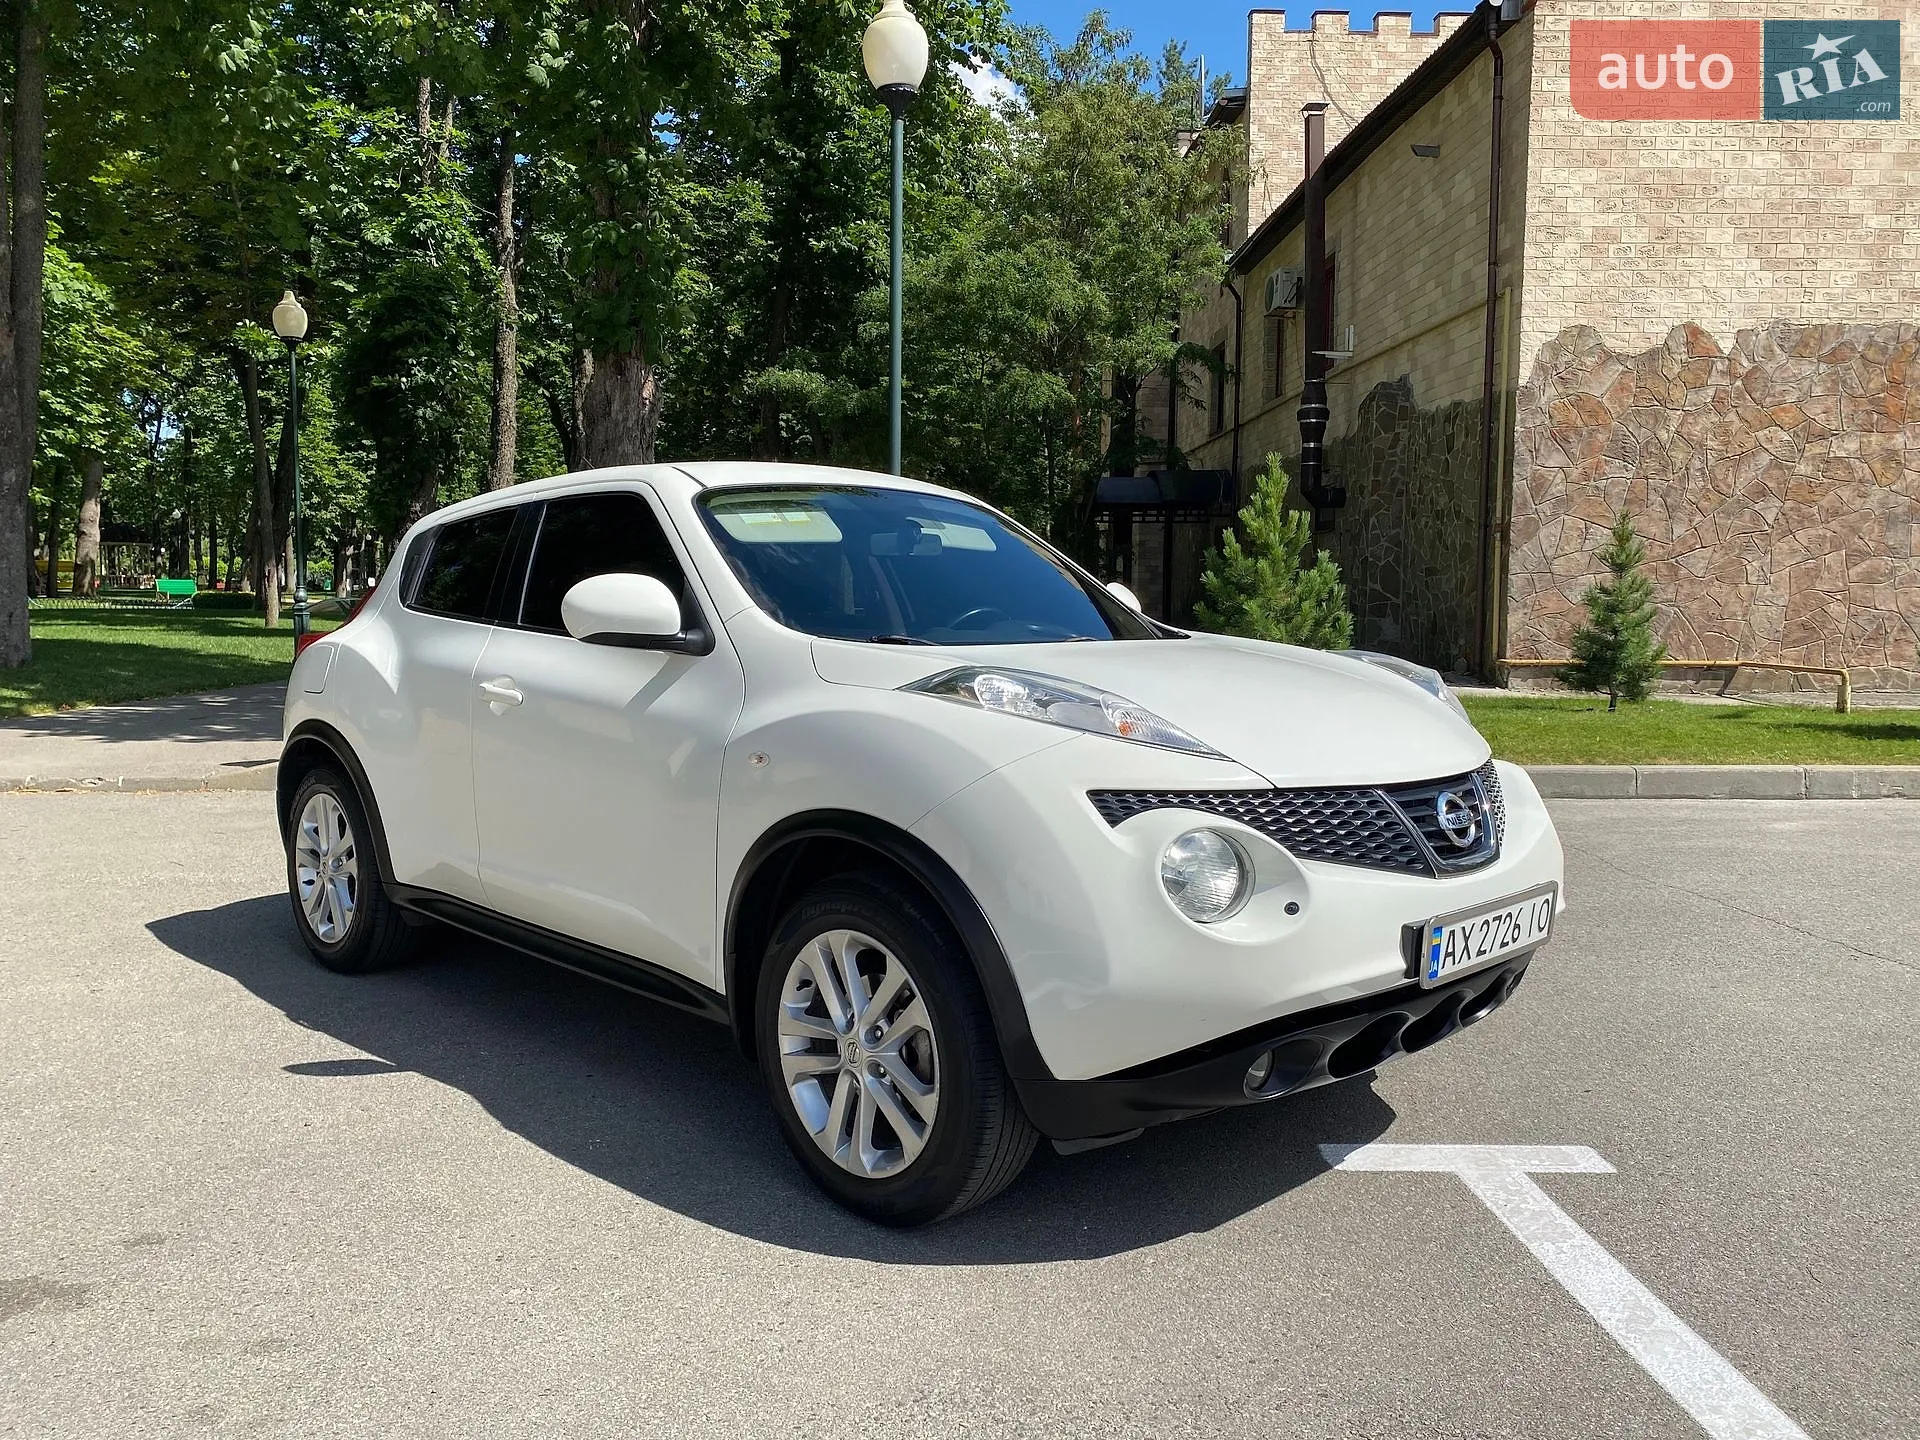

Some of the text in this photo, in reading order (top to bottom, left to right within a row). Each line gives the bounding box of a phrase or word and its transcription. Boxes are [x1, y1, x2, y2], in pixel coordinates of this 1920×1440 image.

[1441, 898, 1550, 970] AX 2726 IO
